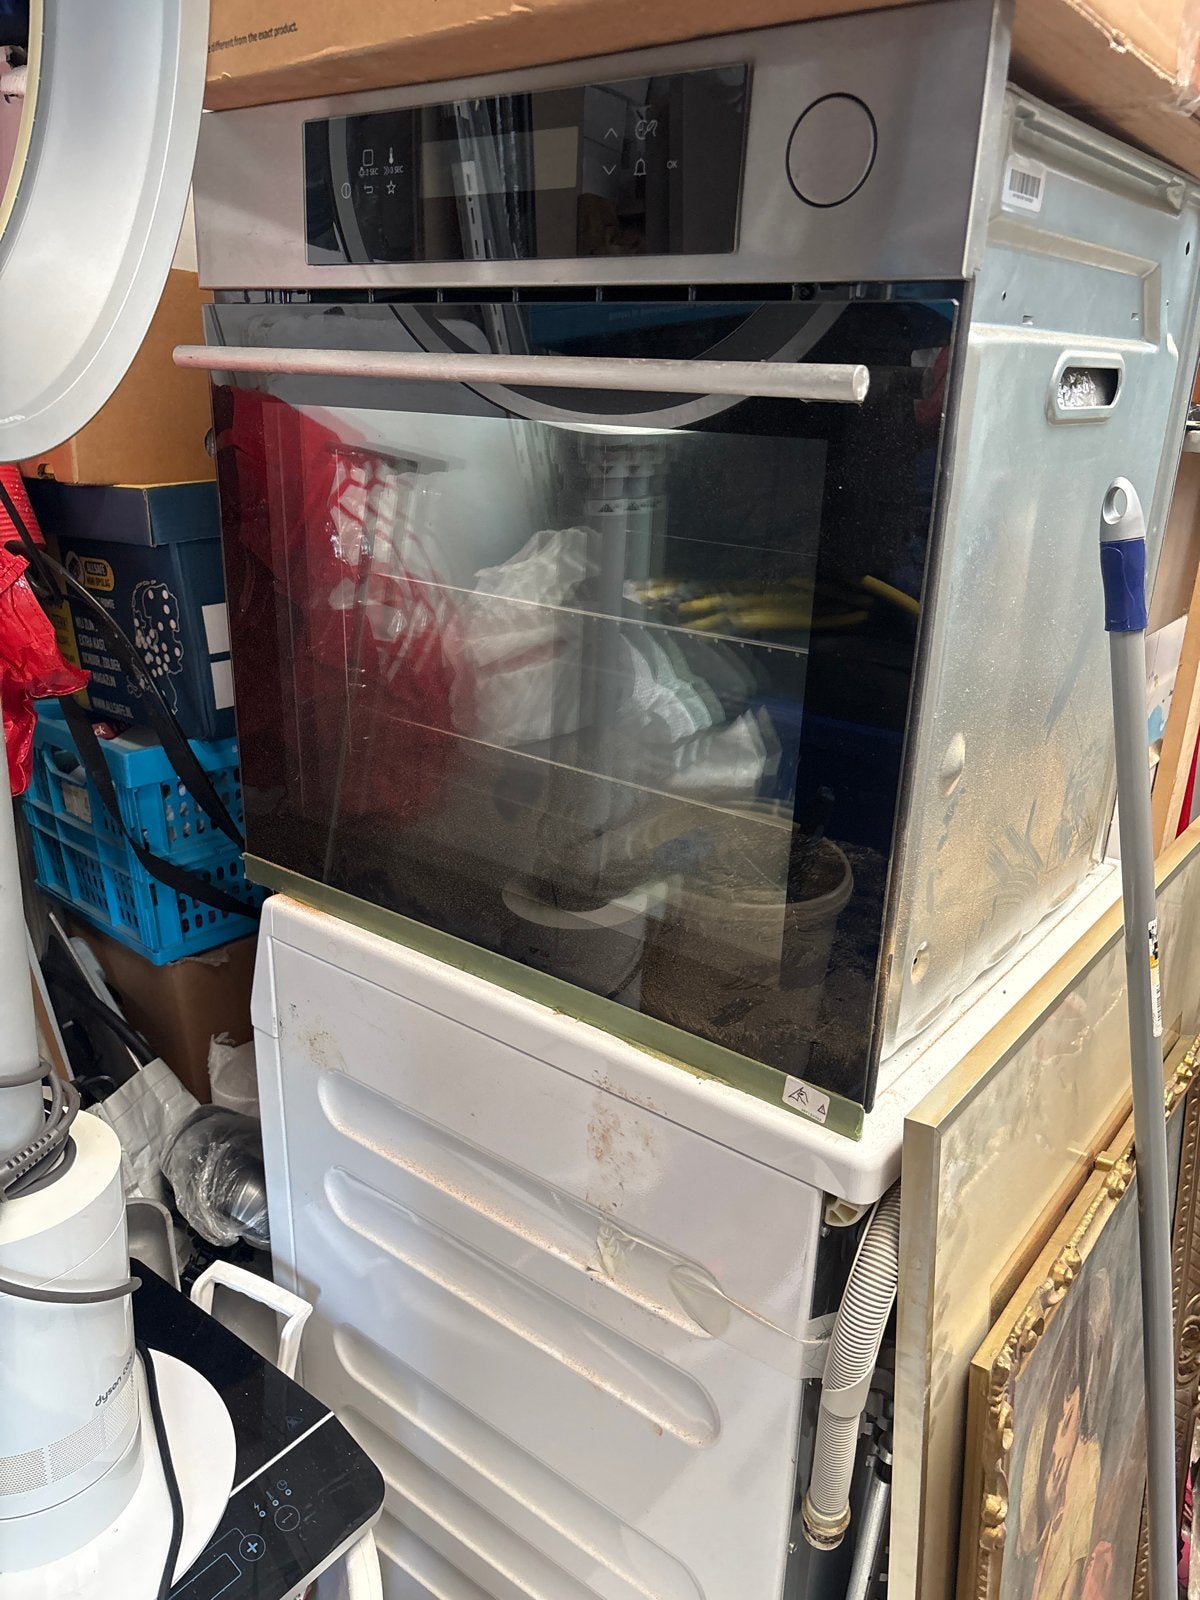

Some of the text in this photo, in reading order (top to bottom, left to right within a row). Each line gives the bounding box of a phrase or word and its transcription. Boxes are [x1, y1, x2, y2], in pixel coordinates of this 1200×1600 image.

[211, 40, 234, 52] different
[234, 35, 248, 46] from
[248, 32, 258, 43] the
[258, 28, 273, 41] exact
[394, 165, 404, 174] SEC
[666, 160, 678, 169] OK
[369, 167, 379, 176] SEC
[86, 562, 106, 576] ALLSAFE
[95, 1376, 122, 1407] dyson
